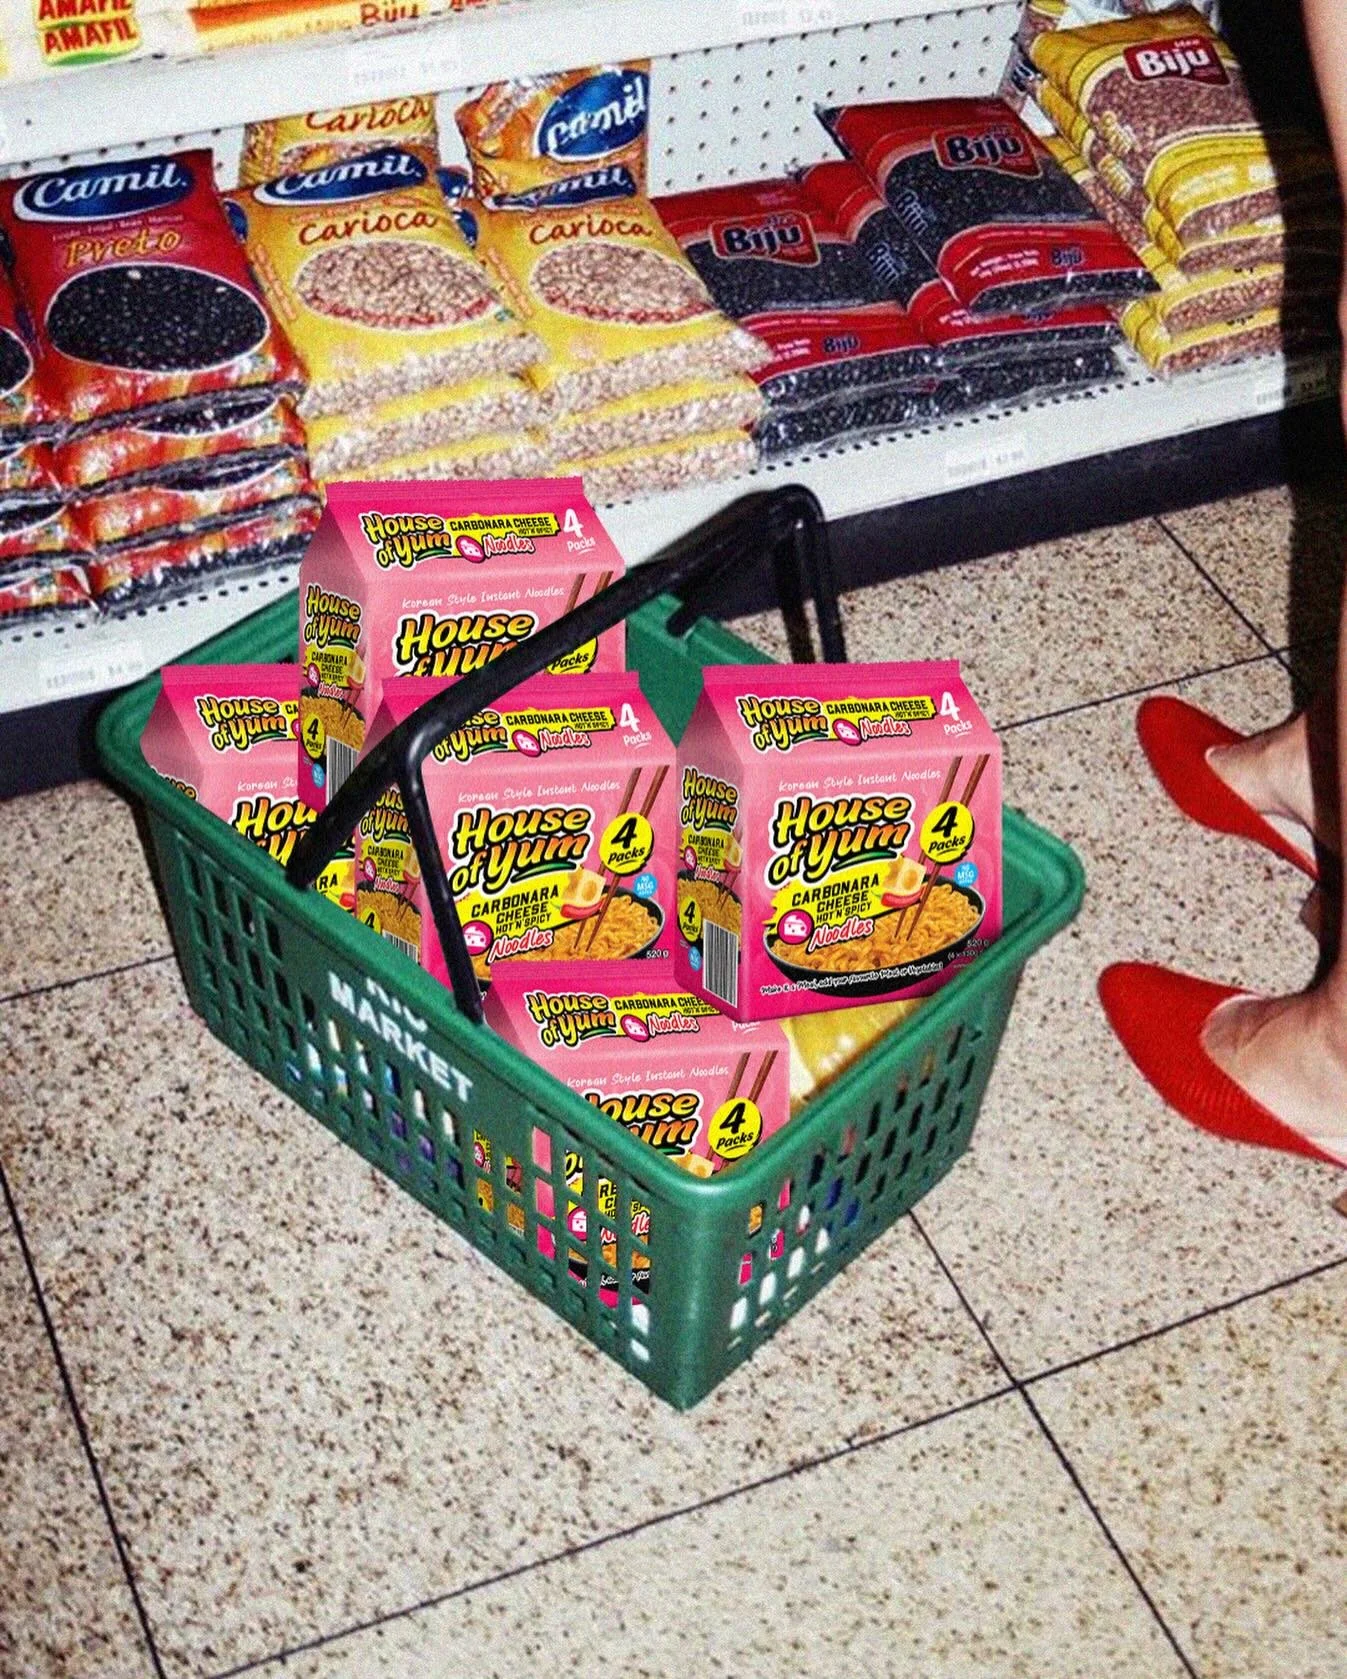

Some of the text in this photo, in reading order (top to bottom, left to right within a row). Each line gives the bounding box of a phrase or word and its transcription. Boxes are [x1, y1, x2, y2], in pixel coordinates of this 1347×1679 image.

[45, 18, 137, 54] AMAFIL
[1136, 49, 1211, 77] Biju
[945, 134, 1024, 166] Biju
[65, 228, 182, 269] Preto
[723, 225, 803, 256] Biju
[364, 508, 584, 543] House CARBONARA CHEESE 4
[377, 542, 398, 567] of
[483, 533, 535, 557] Noodles
[567, 537, 596, 552] Packs
[306, 585, 361, 623] House
[402, 586, 566, 610] Korean Style Instant Noodles
[304, 615, 319, 642] of
[396, 613, 535, 664] House
[311, 651, 348, 666] CARBONARA
[551, 652, 590, 671] Packs
[197, 696, 280, 727] House
[505, 713, 569, 726] CARBONARA
[569, 711, 608, 724] CHEESE
[620, 703, 640, 733] 4
[738, 691, 960, 728] House CARBONARA CHEESE 4
[212, 721, 232, 751] of
[307, 717, 319, 740] 4
[539, 728, 591, 751] Noodles
[623, 731, 652, 746] Packs
[753, 723, 772, 751] of
[860, 716, 912, 740] Noodles
[944, 720, 973, 735] Packs
[237, 780, 278, 792] Korean
[458, 779, 621, 803] Korean Style Instant Noodles
[683, 769, 738, 804] House
[779, 769, 942, 792] Korean Style Instant Noodles
[232, 796, 318, 839] Hou
[681, 799, 696, 825] of
[773, 796, 912, 849] House
[931, 805, 959, 838] 4
[451, 807, 592, 860] House
[611, 817, 638, 849] 4
[688, 834, 725, 848] CARBONARA
[929, 832, 966, 851] Packs
[367, 845, 404, 861] CARBONARA
[608, 847, 645, 866] Packs
[768, 838, 808, 885] of
[450, 848, 489, 897] of
[471, 884, 559, 918] CARBONARA
[792, 873, 879, 907] CARBONARA
[817, 890, 869, 913] CHEESE
[496, 900, 549, 924] CHEESE
[524, 912, 551, 928] SPICY
[684, 900, 696, 923] 4
[844, 901, 872, 916] SPICY
[488, 926, 555, 964] Noodles
[807, 915, 874, 954] Noodles
[647, 951, 662, 959] 520
[528, 992, 609, 1024] House
[615, 998, 676, 1011] CARBONARA
[678, 996, 705, 1007] CHEE
[328, 970, 473, 1102] MARKET
[541, 1018, 560, 1047] of
[648, 1011, 700, 1037] Noodles
[567, 1066, 729, 1088] Korean Style Instant Noodles
[720, 1102, 746, 1134] 4
[716, 1132, 754, 1150] Packs
